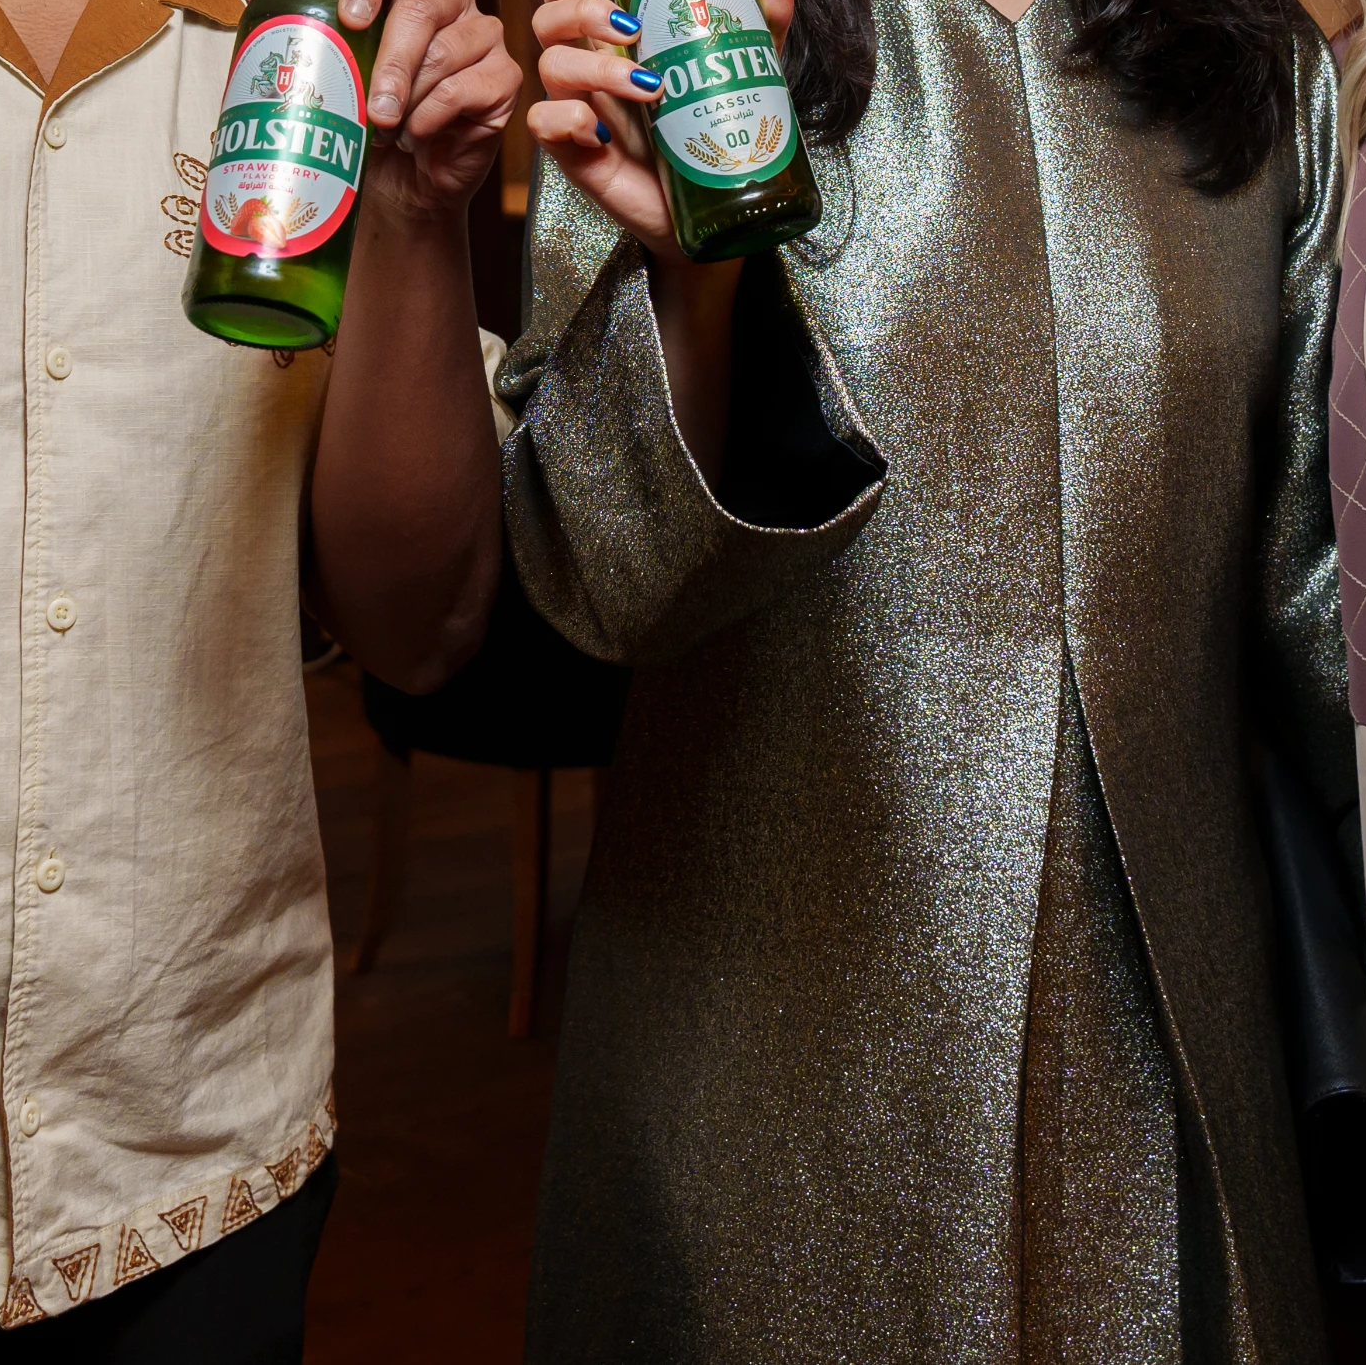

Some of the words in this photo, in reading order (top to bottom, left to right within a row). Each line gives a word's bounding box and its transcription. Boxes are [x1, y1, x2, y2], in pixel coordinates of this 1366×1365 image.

[694, 6, 708, 21] H
[279, 71, 290, 85] H
[693, 93, 762, 118] CLASSIC
[710, 114, 731, 128] شعير
[732, 109, 754, 123] شراب
[212, 118, 354, 171] HOLSTEN
[725, 129, 750, 149] 0.0
[242, 173, 292, 182] FLAVO
